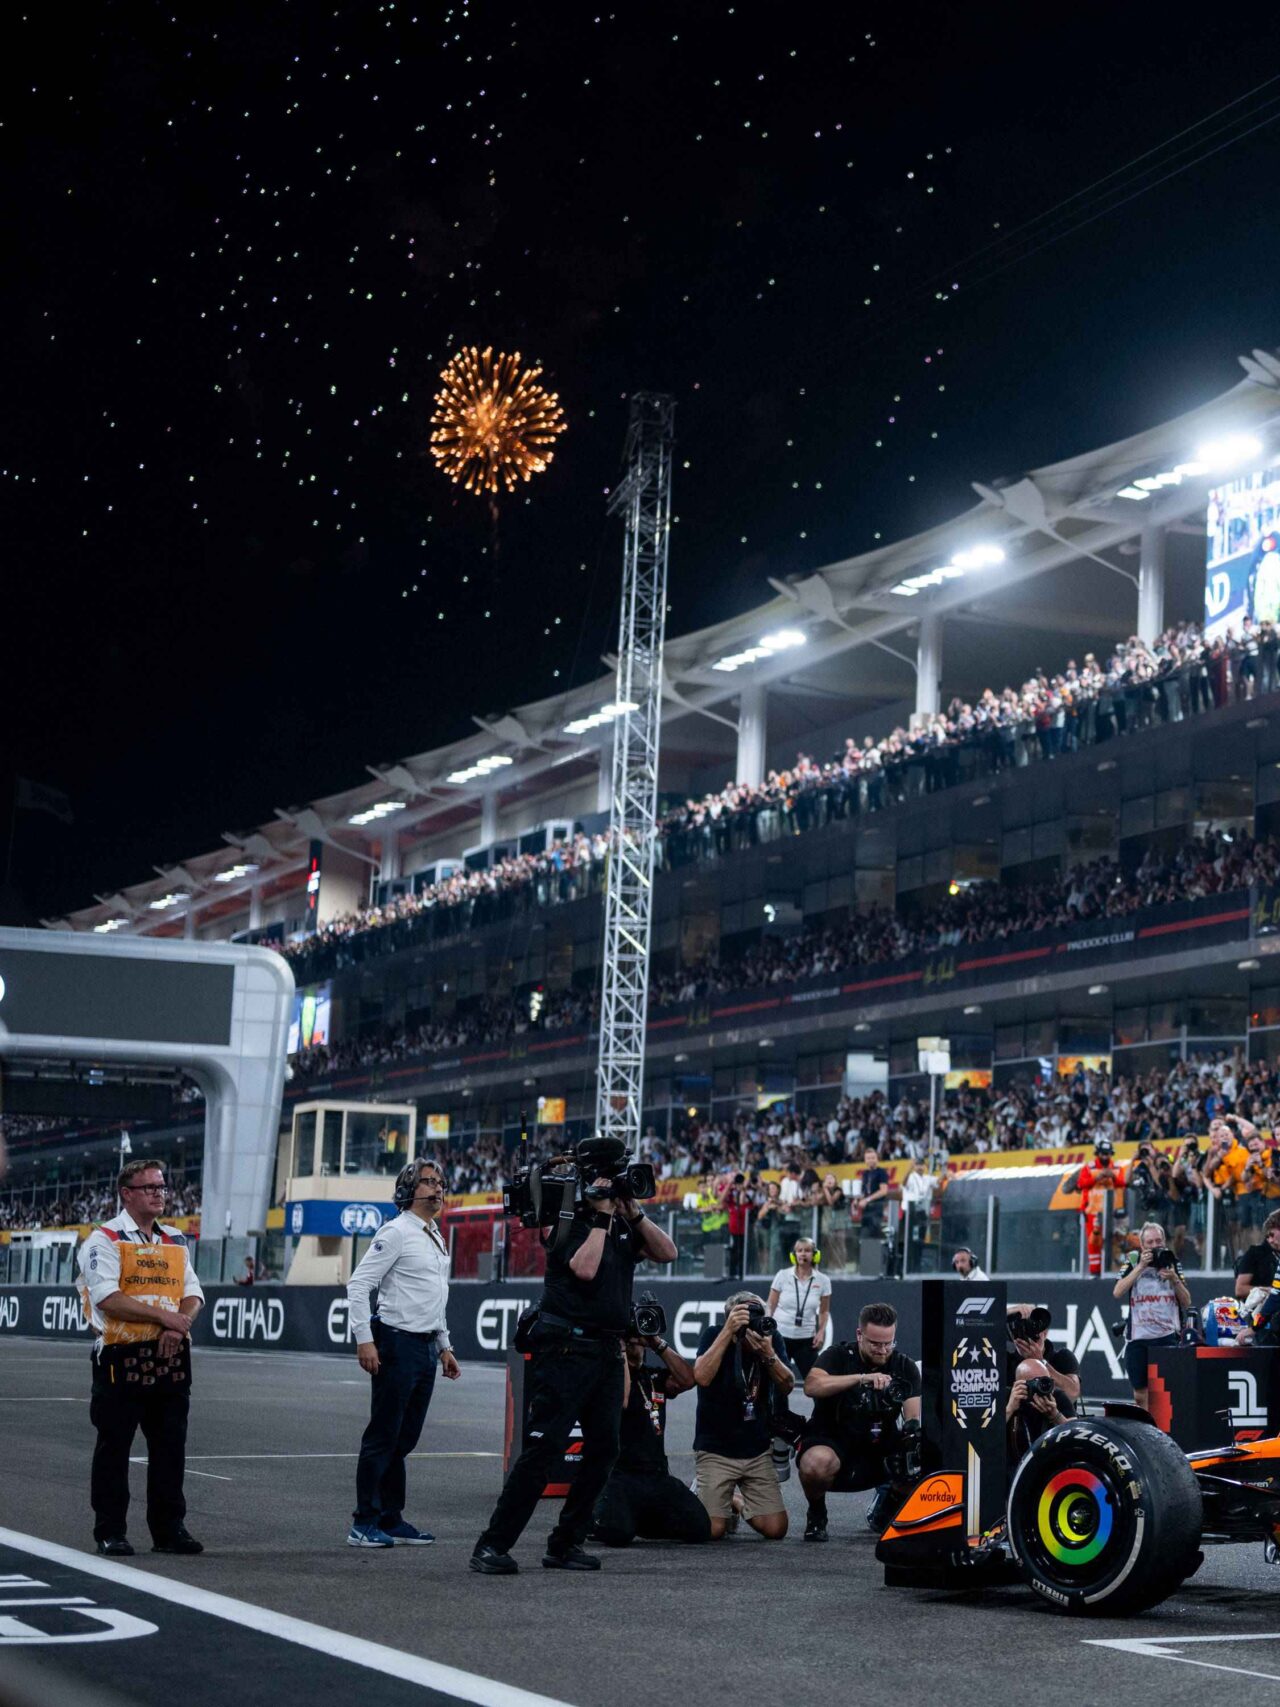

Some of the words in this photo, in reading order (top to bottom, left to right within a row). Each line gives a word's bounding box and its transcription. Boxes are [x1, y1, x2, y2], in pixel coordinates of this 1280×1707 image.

[344, 1208, 378, 1229] FIA
[956, 1297, 995, 1314] F1
[212, 1298, 284, 1341] ETIHAD
[951, 1369, 999, 1383] WORLD
[951, 1382, 1000, 1393] CHAMPION
[958, 1393, 992, 1408] 2025
[1228, 1371, 1268, 1427] 1
[1056, 1430, 1072, 1442] P
[1074, 1429, 1132, 1470] ZERO
[920, 1491, 957, 1504] workday
[1033, 1578, 1069, 1607] PIRELLI
